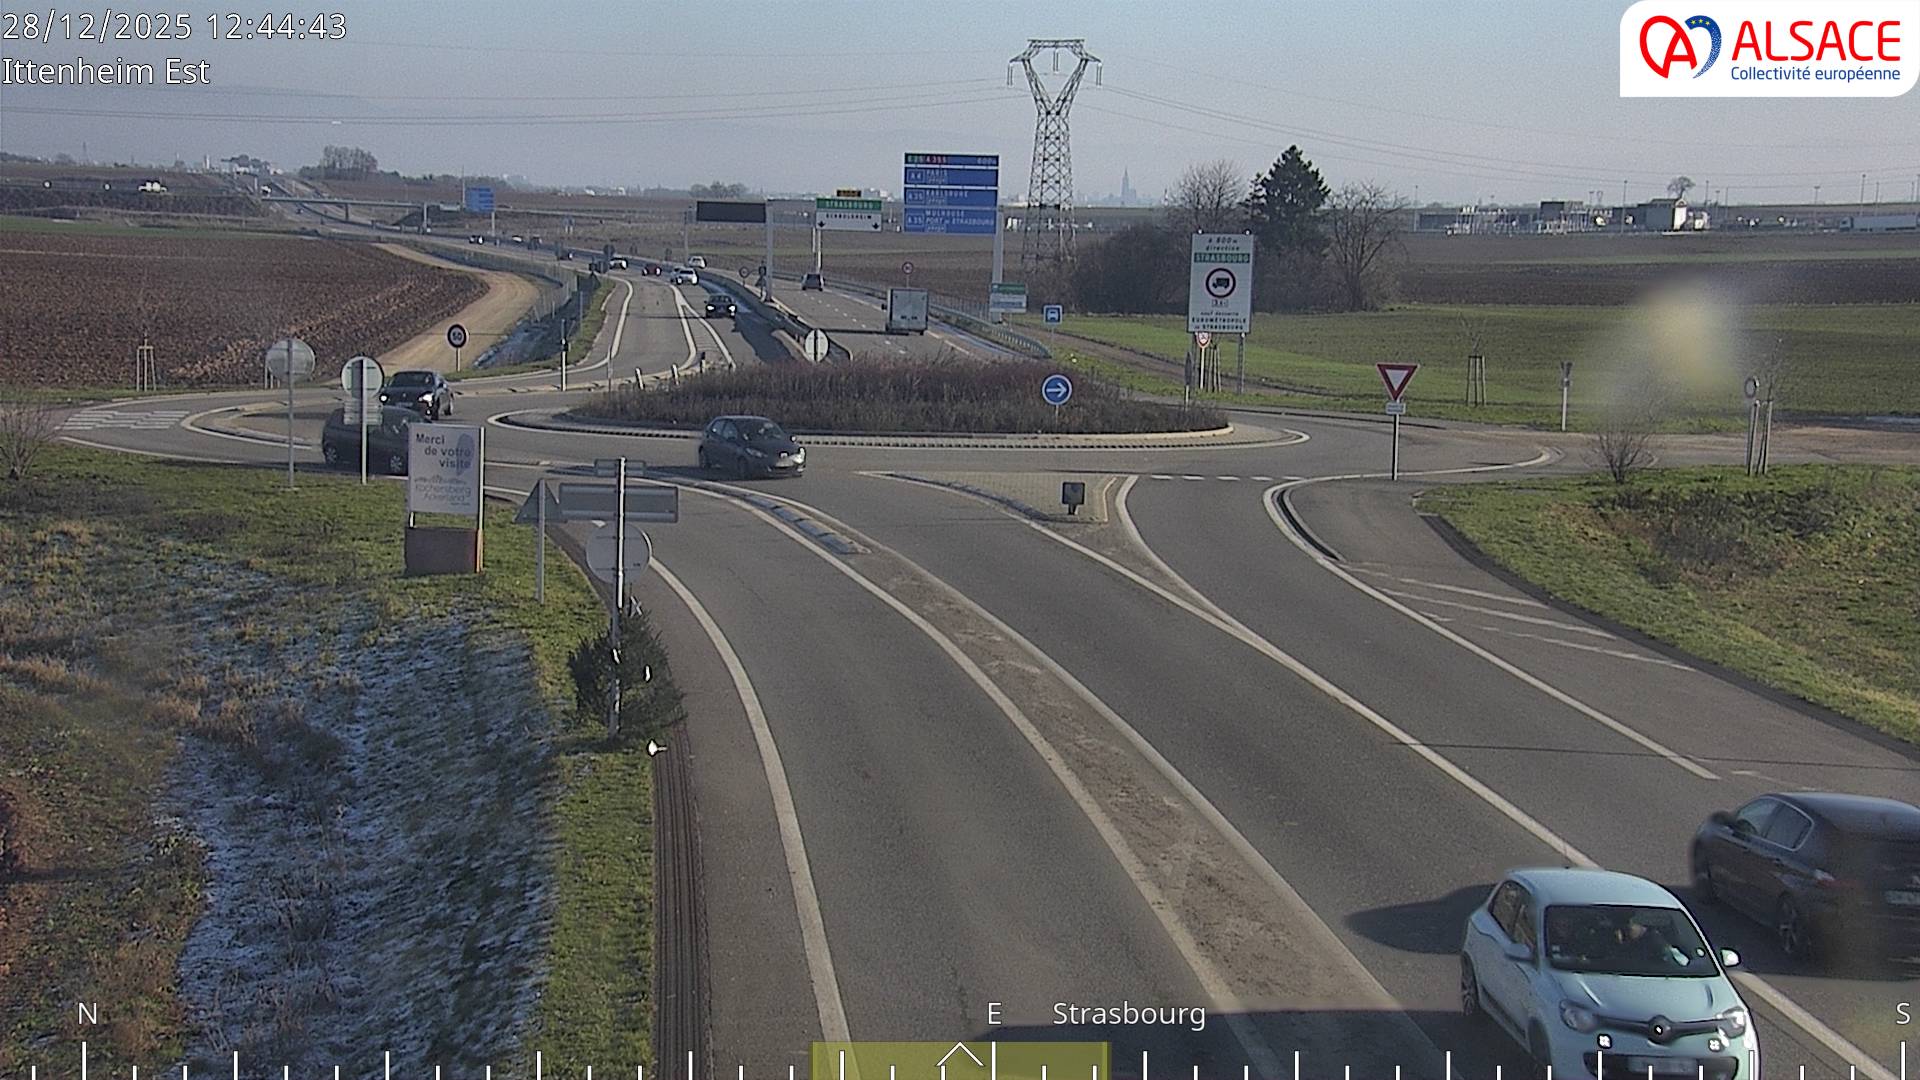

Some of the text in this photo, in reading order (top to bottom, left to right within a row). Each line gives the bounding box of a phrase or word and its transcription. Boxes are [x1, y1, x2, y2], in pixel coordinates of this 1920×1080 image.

[1195, 254, 1249, 262] STRASBOURG
[452, 331, 463, 341] 50
[416, 433, 445, 445] Merci
[424, 446, 472, 457] de votre
[439, 458, 472, 468] visite
